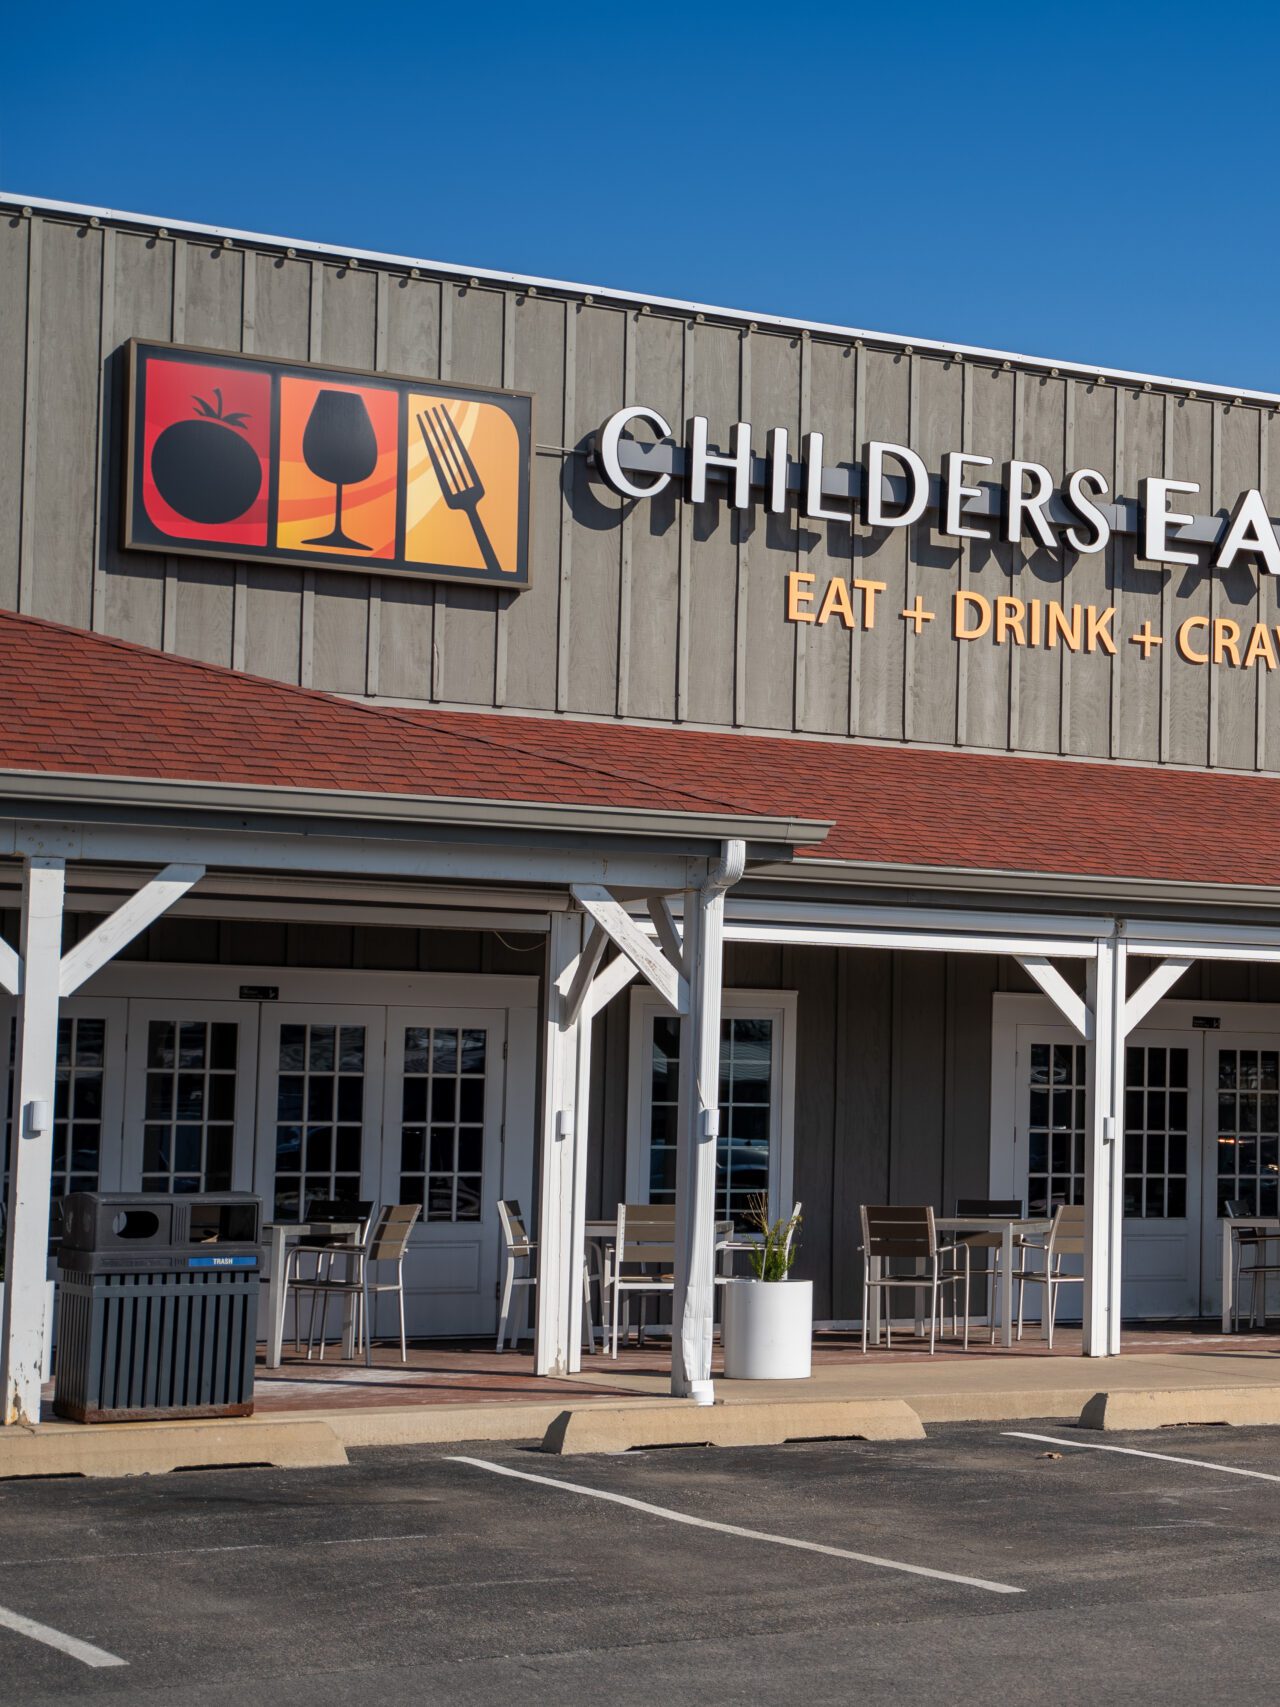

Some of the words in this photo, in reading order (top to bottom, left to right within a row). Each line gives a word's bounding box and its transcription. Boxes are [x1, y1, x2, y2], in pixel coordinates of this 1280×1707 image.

[600, 405, 1110, 553] CHILDERS
[788, 571, 887, 629] EAT
[954, 590, 1117, 655] DRINK
[213, 1257, 233, 1265] TRASH
